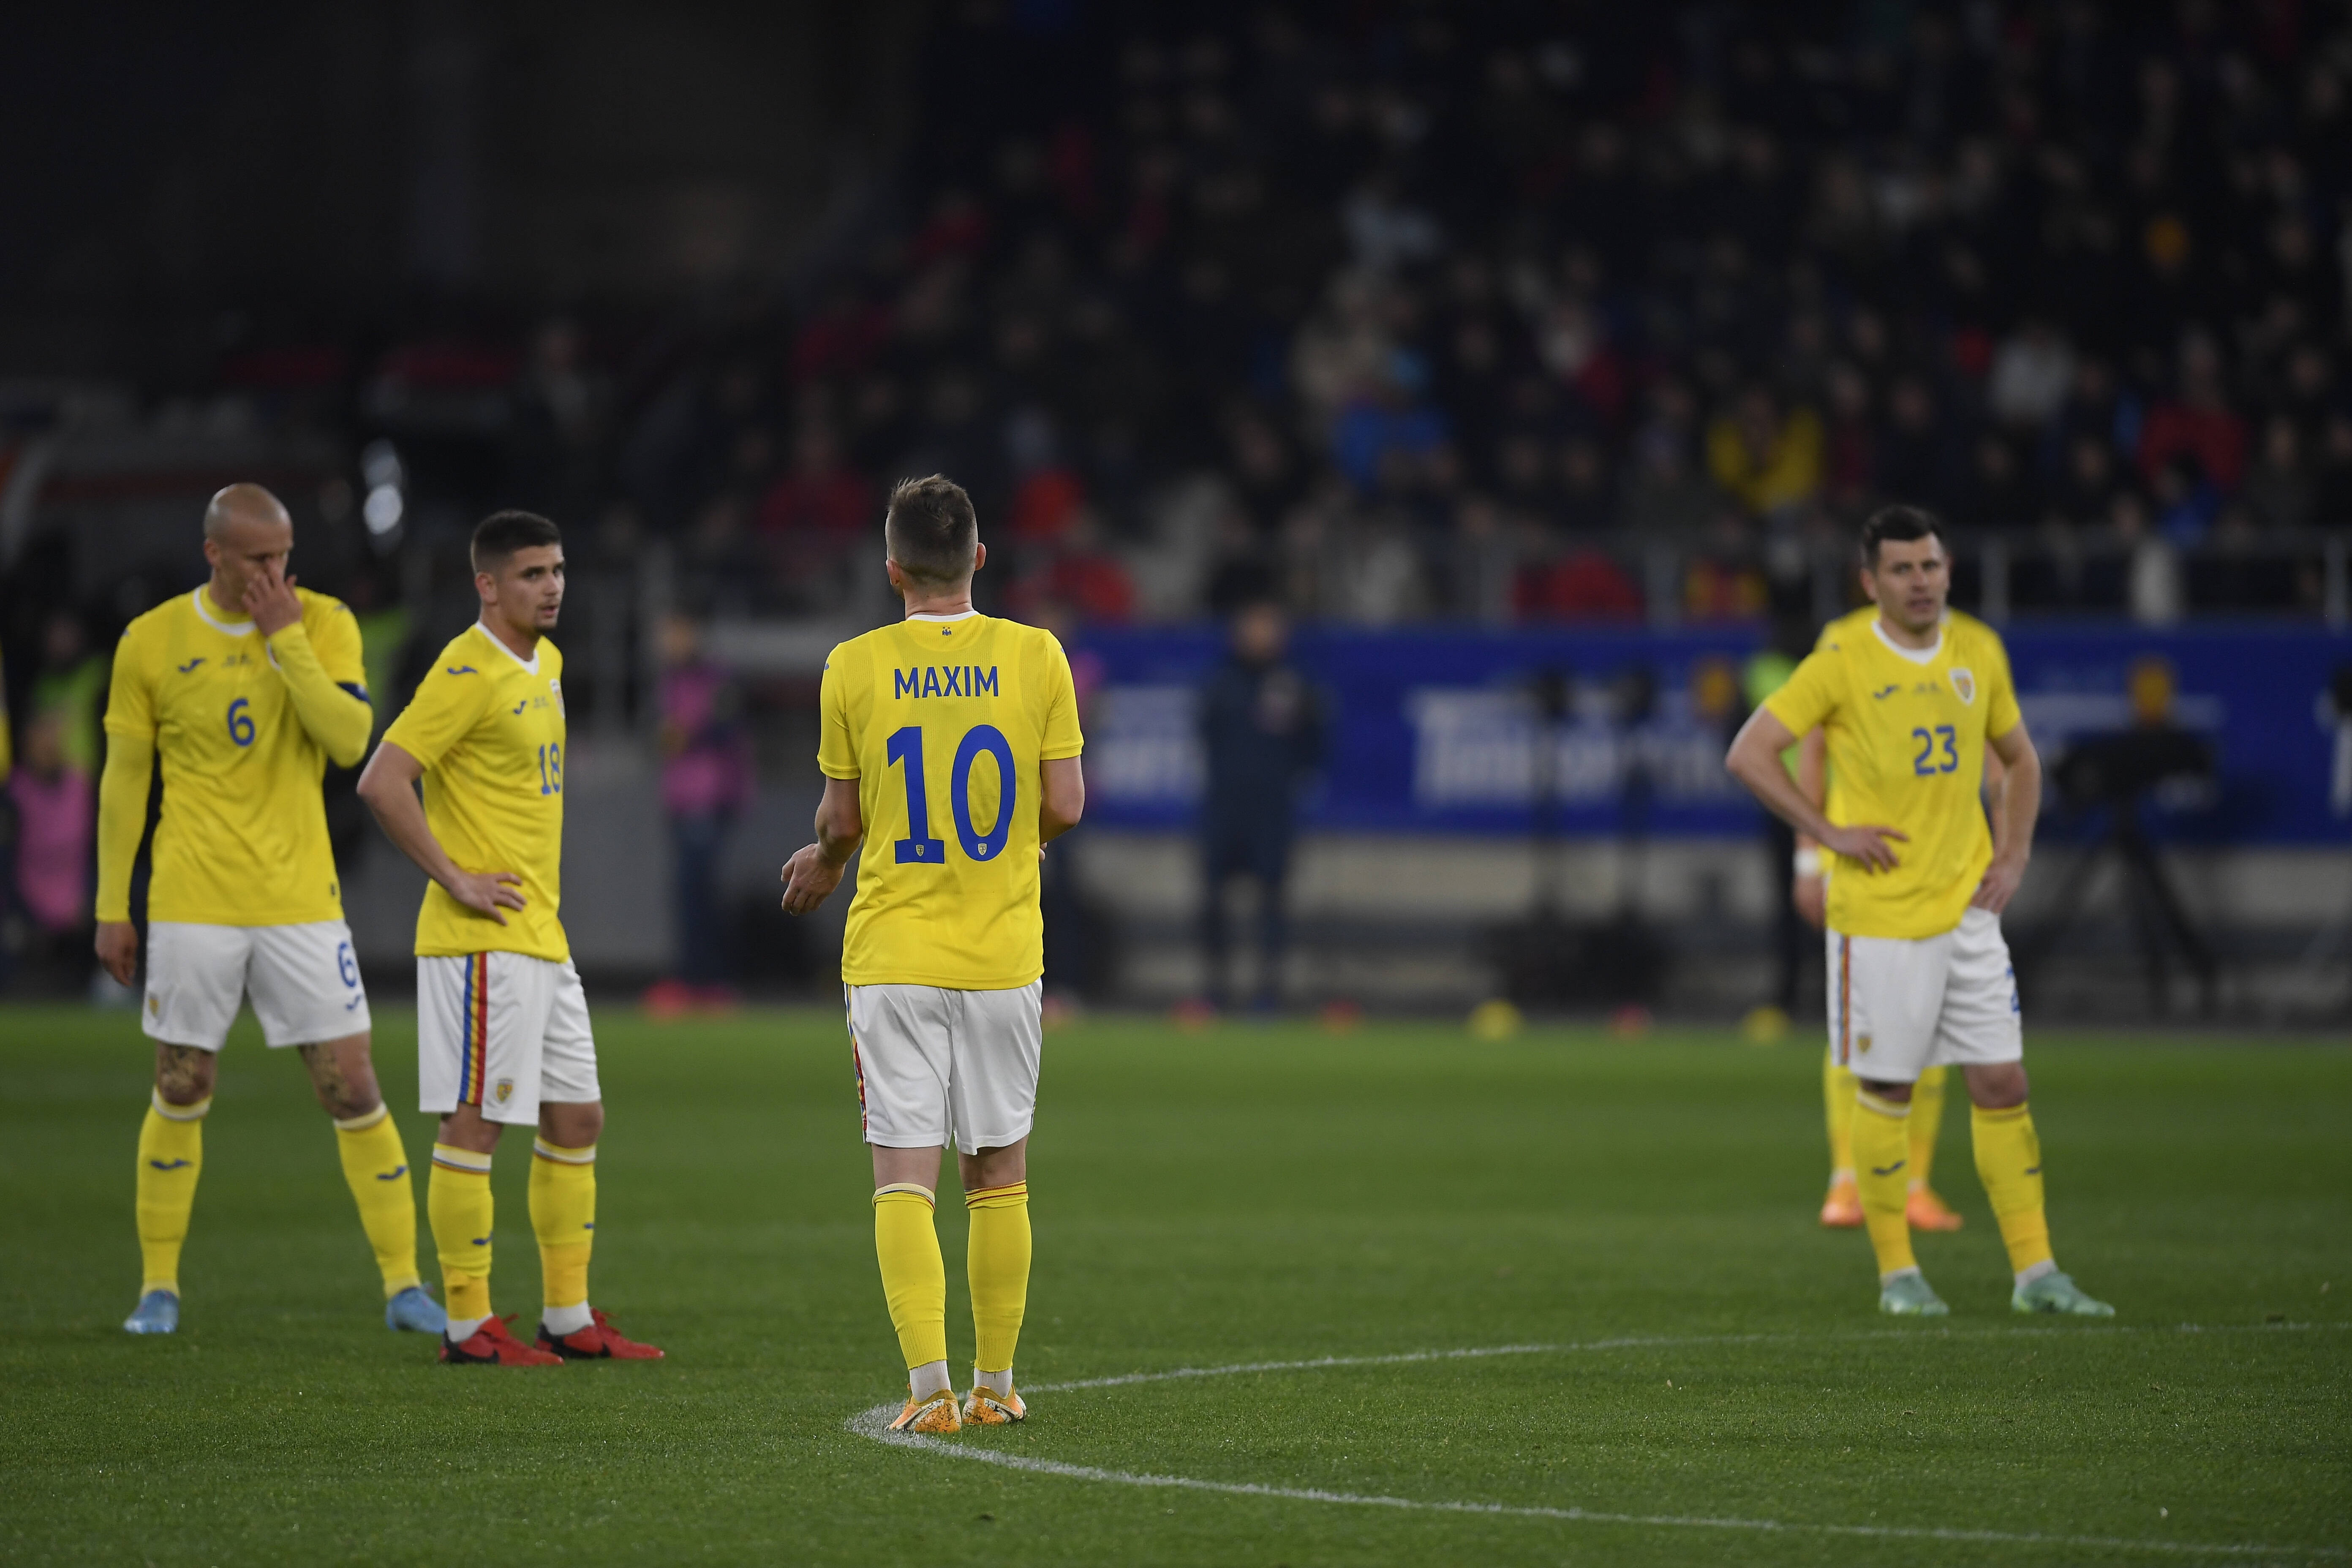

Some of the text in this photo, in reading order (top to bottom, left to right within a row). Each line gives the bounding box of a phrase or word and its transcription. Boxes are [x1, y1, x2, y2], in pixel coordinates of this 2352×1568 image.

[894, 666, 998, 699] MAXIM
[228, 699, 255, 747] 6
[539, 742, 562, 795] 18
[1912, 725, 1958, 776] 23
[887, 724, 1016, 864] 10
[338, 942, 357, 988] 6
